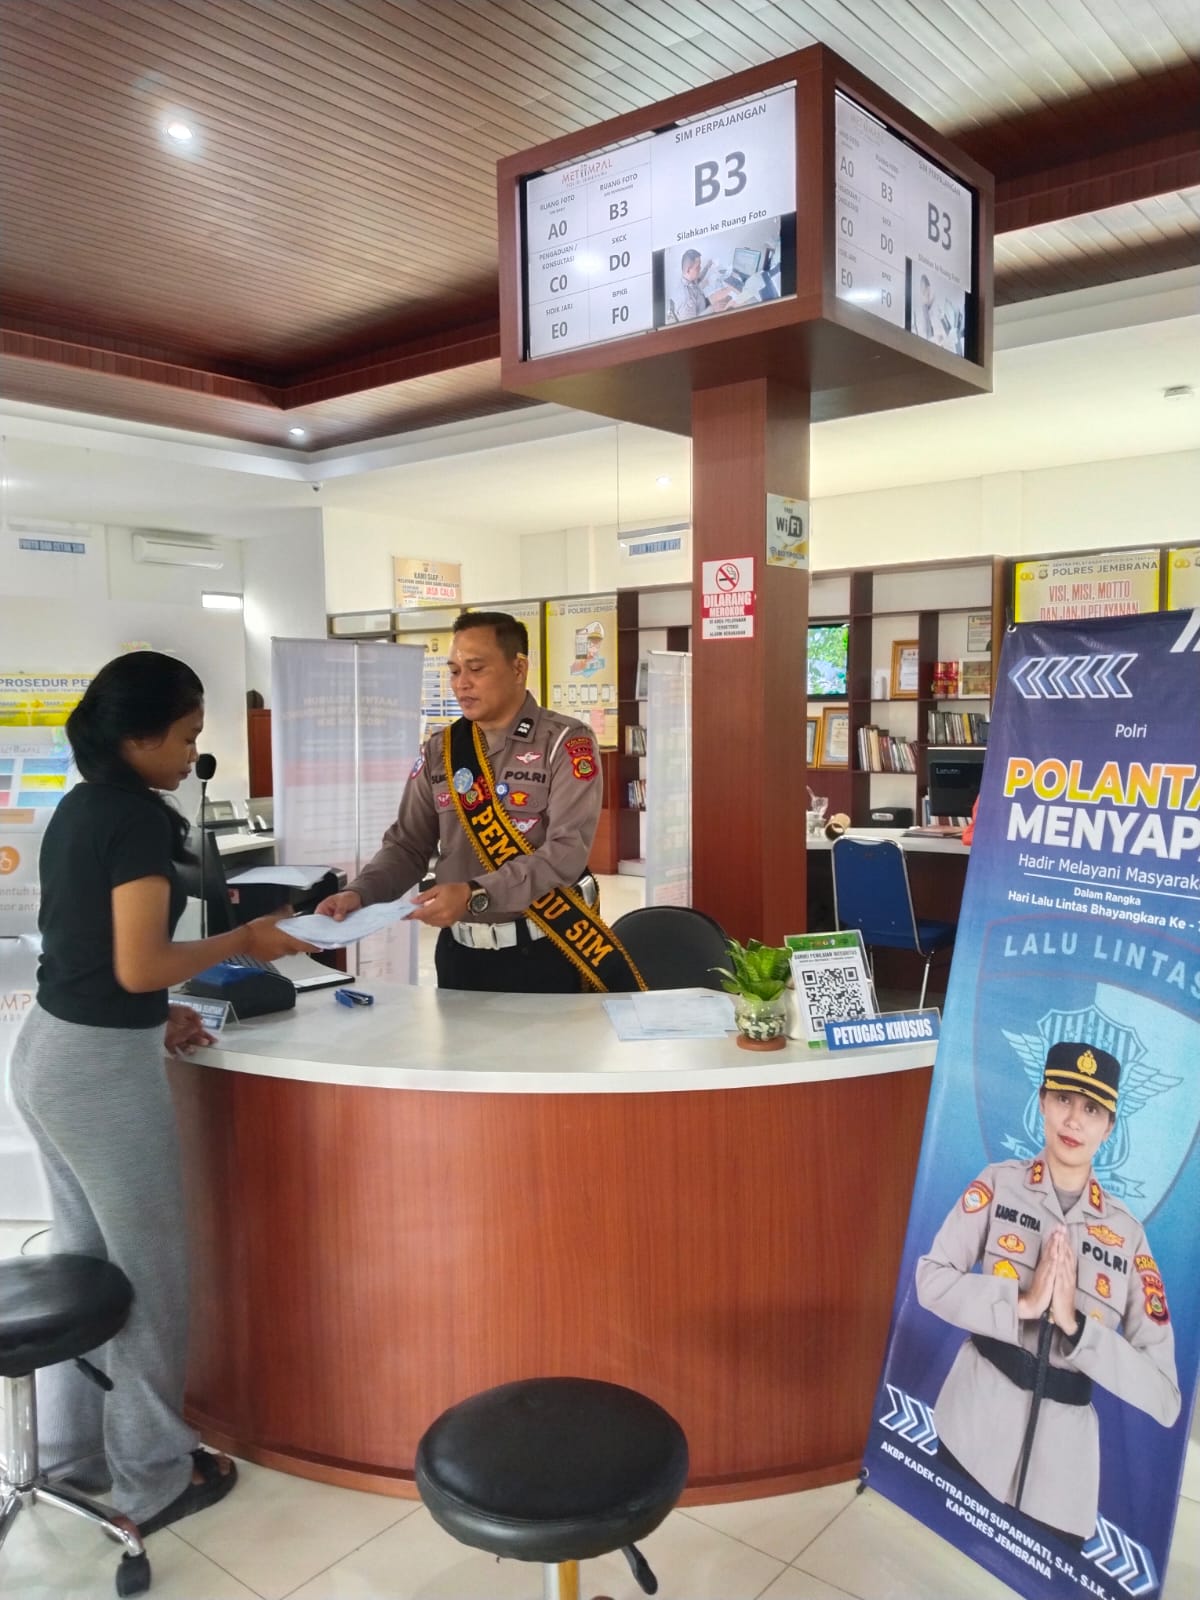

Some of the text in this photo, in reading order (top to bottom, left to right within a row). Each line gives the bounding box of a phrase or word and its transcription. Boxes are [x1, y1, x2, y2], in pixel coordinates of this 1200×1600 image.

[675, 104, 767, 144] SIM PERPAJANGAN
[840, 155, 854, 178] A0
[599, 177, 621, 191] RUANG
[622, 173, 638, 184] FOTO
[694, 150, 747, 207] B3
[540, 199, 559, 211] RUANG
[561, 194, 575, 205] FOTO
[881, 182, 893, 203] B3
[609, 200, 628, 221] B3
[548, 219, 568, 240] A0
[676, 209, 767, 241] Silahkan ke Ruang Foto
[840, 217, 853, 237] C0
[928, 201, 952, 251] B3
[880, 233, 893, 255] D0
[609, 251, 630, 272] D0
[549, 274, 568, 293] C0
[561, 304, 573, 312] JARI
[612, 305, 629, 324] F0
[551, 321, 568, 339] E0
[1052, 561, 1159, 577] POLRES JEMBRANA
[704, 591, 751, 608] DILARANG
[1099, 581, 1131, 599] MOTTO
[709, 605, 745, 618] MEROKOK
[0, 678, 91, 688] PROSEDUR PE
[1115, 723, 1148, 739] Polri
[504, 771, 547, 784] POLRI
[1006, 802, 1200, 862] MENYAP
[1018, 853, 1200, 891] Hadir Melayani Masyarak
[1073, 886, 1141, 906] Dalam Rangka
[1008, 890, 1030, 904] Hari
[1031, 894, 1054, 908] Lalu
[1055, 898, 1088, 913] Lintas
[1090, 903, 1166, 927] Bhayangkara
[1169, 916, 1187, 930] Ke
[565, 920, 614, 967] SIM
[1003, 931, 1200, 1000] LALU LINTAS
[833, 1018, 933, 1046] PETUGAS KHUSUS
[1020, 1213, 1041, 1233] CITRA
[1082, 1241, 1128, 1275] POLRI
[880, 1441, 905, 1461] AKBP
[904, 1455, 935, 1482] KADEK
[935, 1476, 963, 1502] CITRA
[963, 1494, 990, 1519] DEWI
[989, 1512, 1053, 1565] SUPARWATI,
[945, 1498, 1052, 1580] KAPOLRES JEMBRANA
